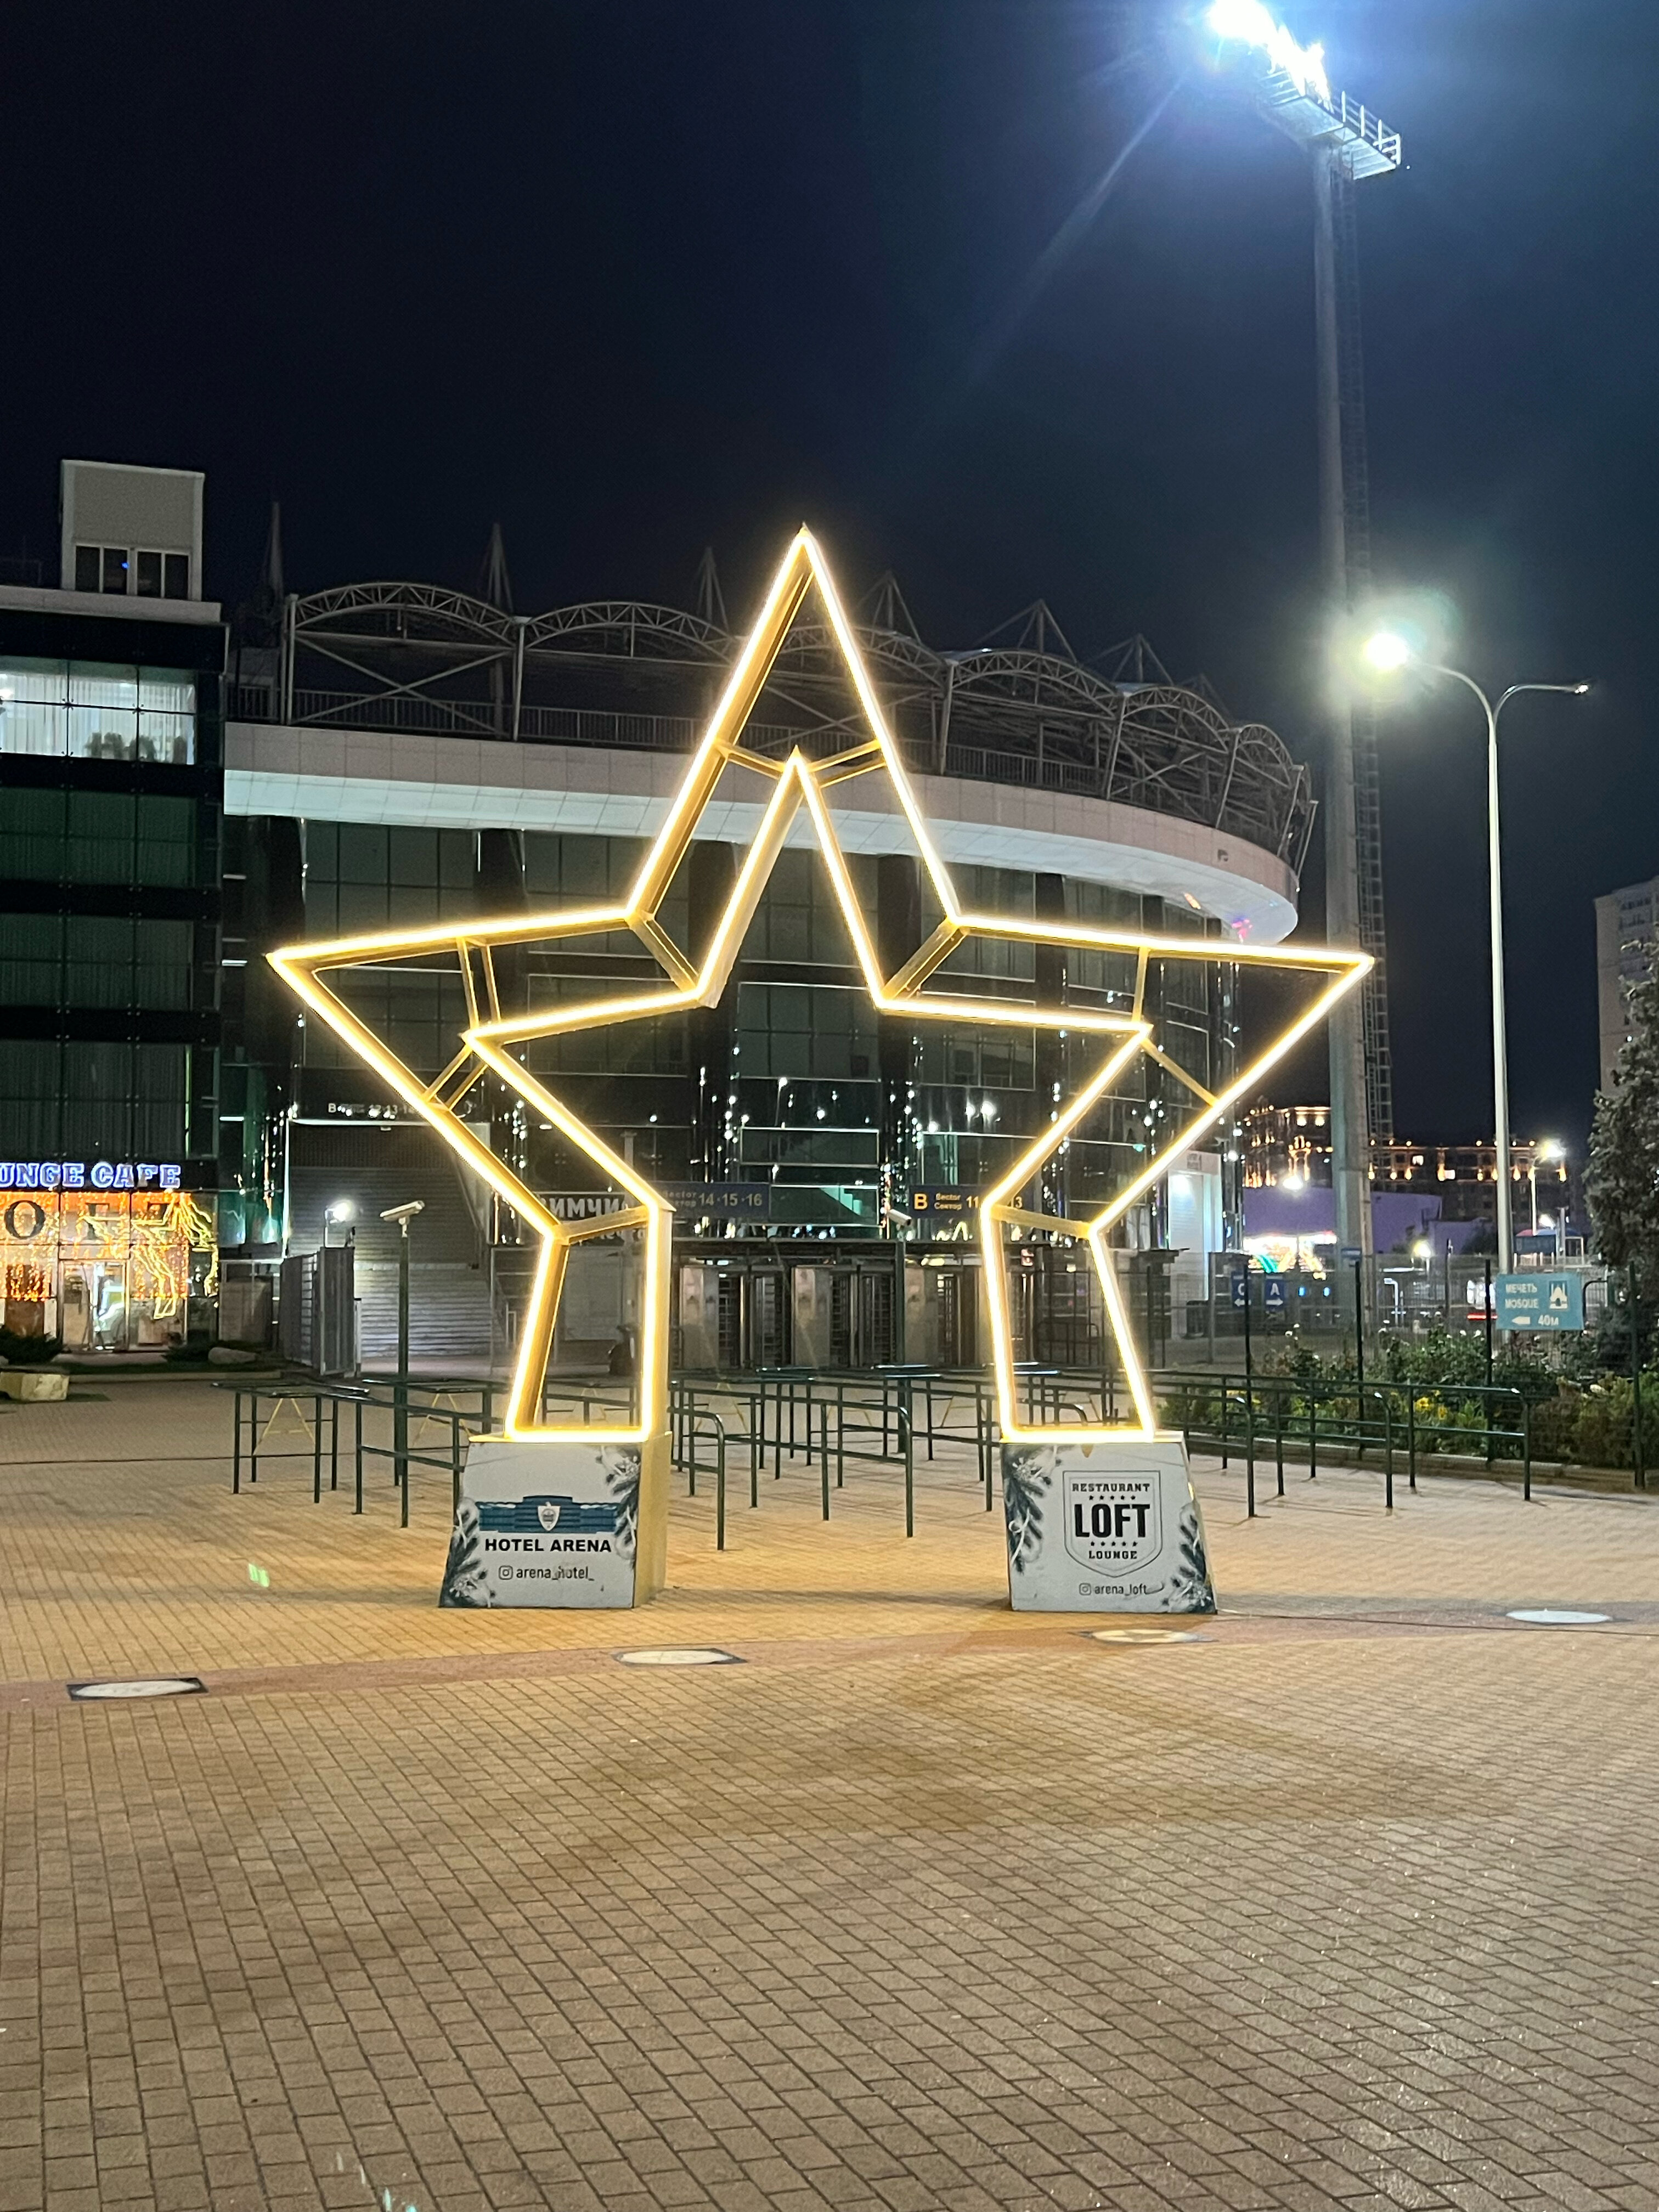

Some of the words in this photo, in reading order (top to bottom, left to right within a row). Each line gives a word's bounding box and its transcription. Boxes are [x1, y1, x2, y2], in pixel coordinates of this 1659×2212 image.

[91, 1162, 180, 1188] CAFE
[914, 1194, 927, 1210] B
[1270, 1283, 1280, 1296] A
[1505, 1283, 1537, 1294] МЕЧЕТЬ
[1505, 1299, 1539, 1309] MOSQUE
[1073, 1483, 1150, 1492] RESTAURANT
[1074, 1503, 1150, 1538] LOFT
[485, 1538, 544, 1551] HOTEL
[550, 1539, 611, 1552] ARENA
[1088, 1550, 1137, 1559] LOUNGE
